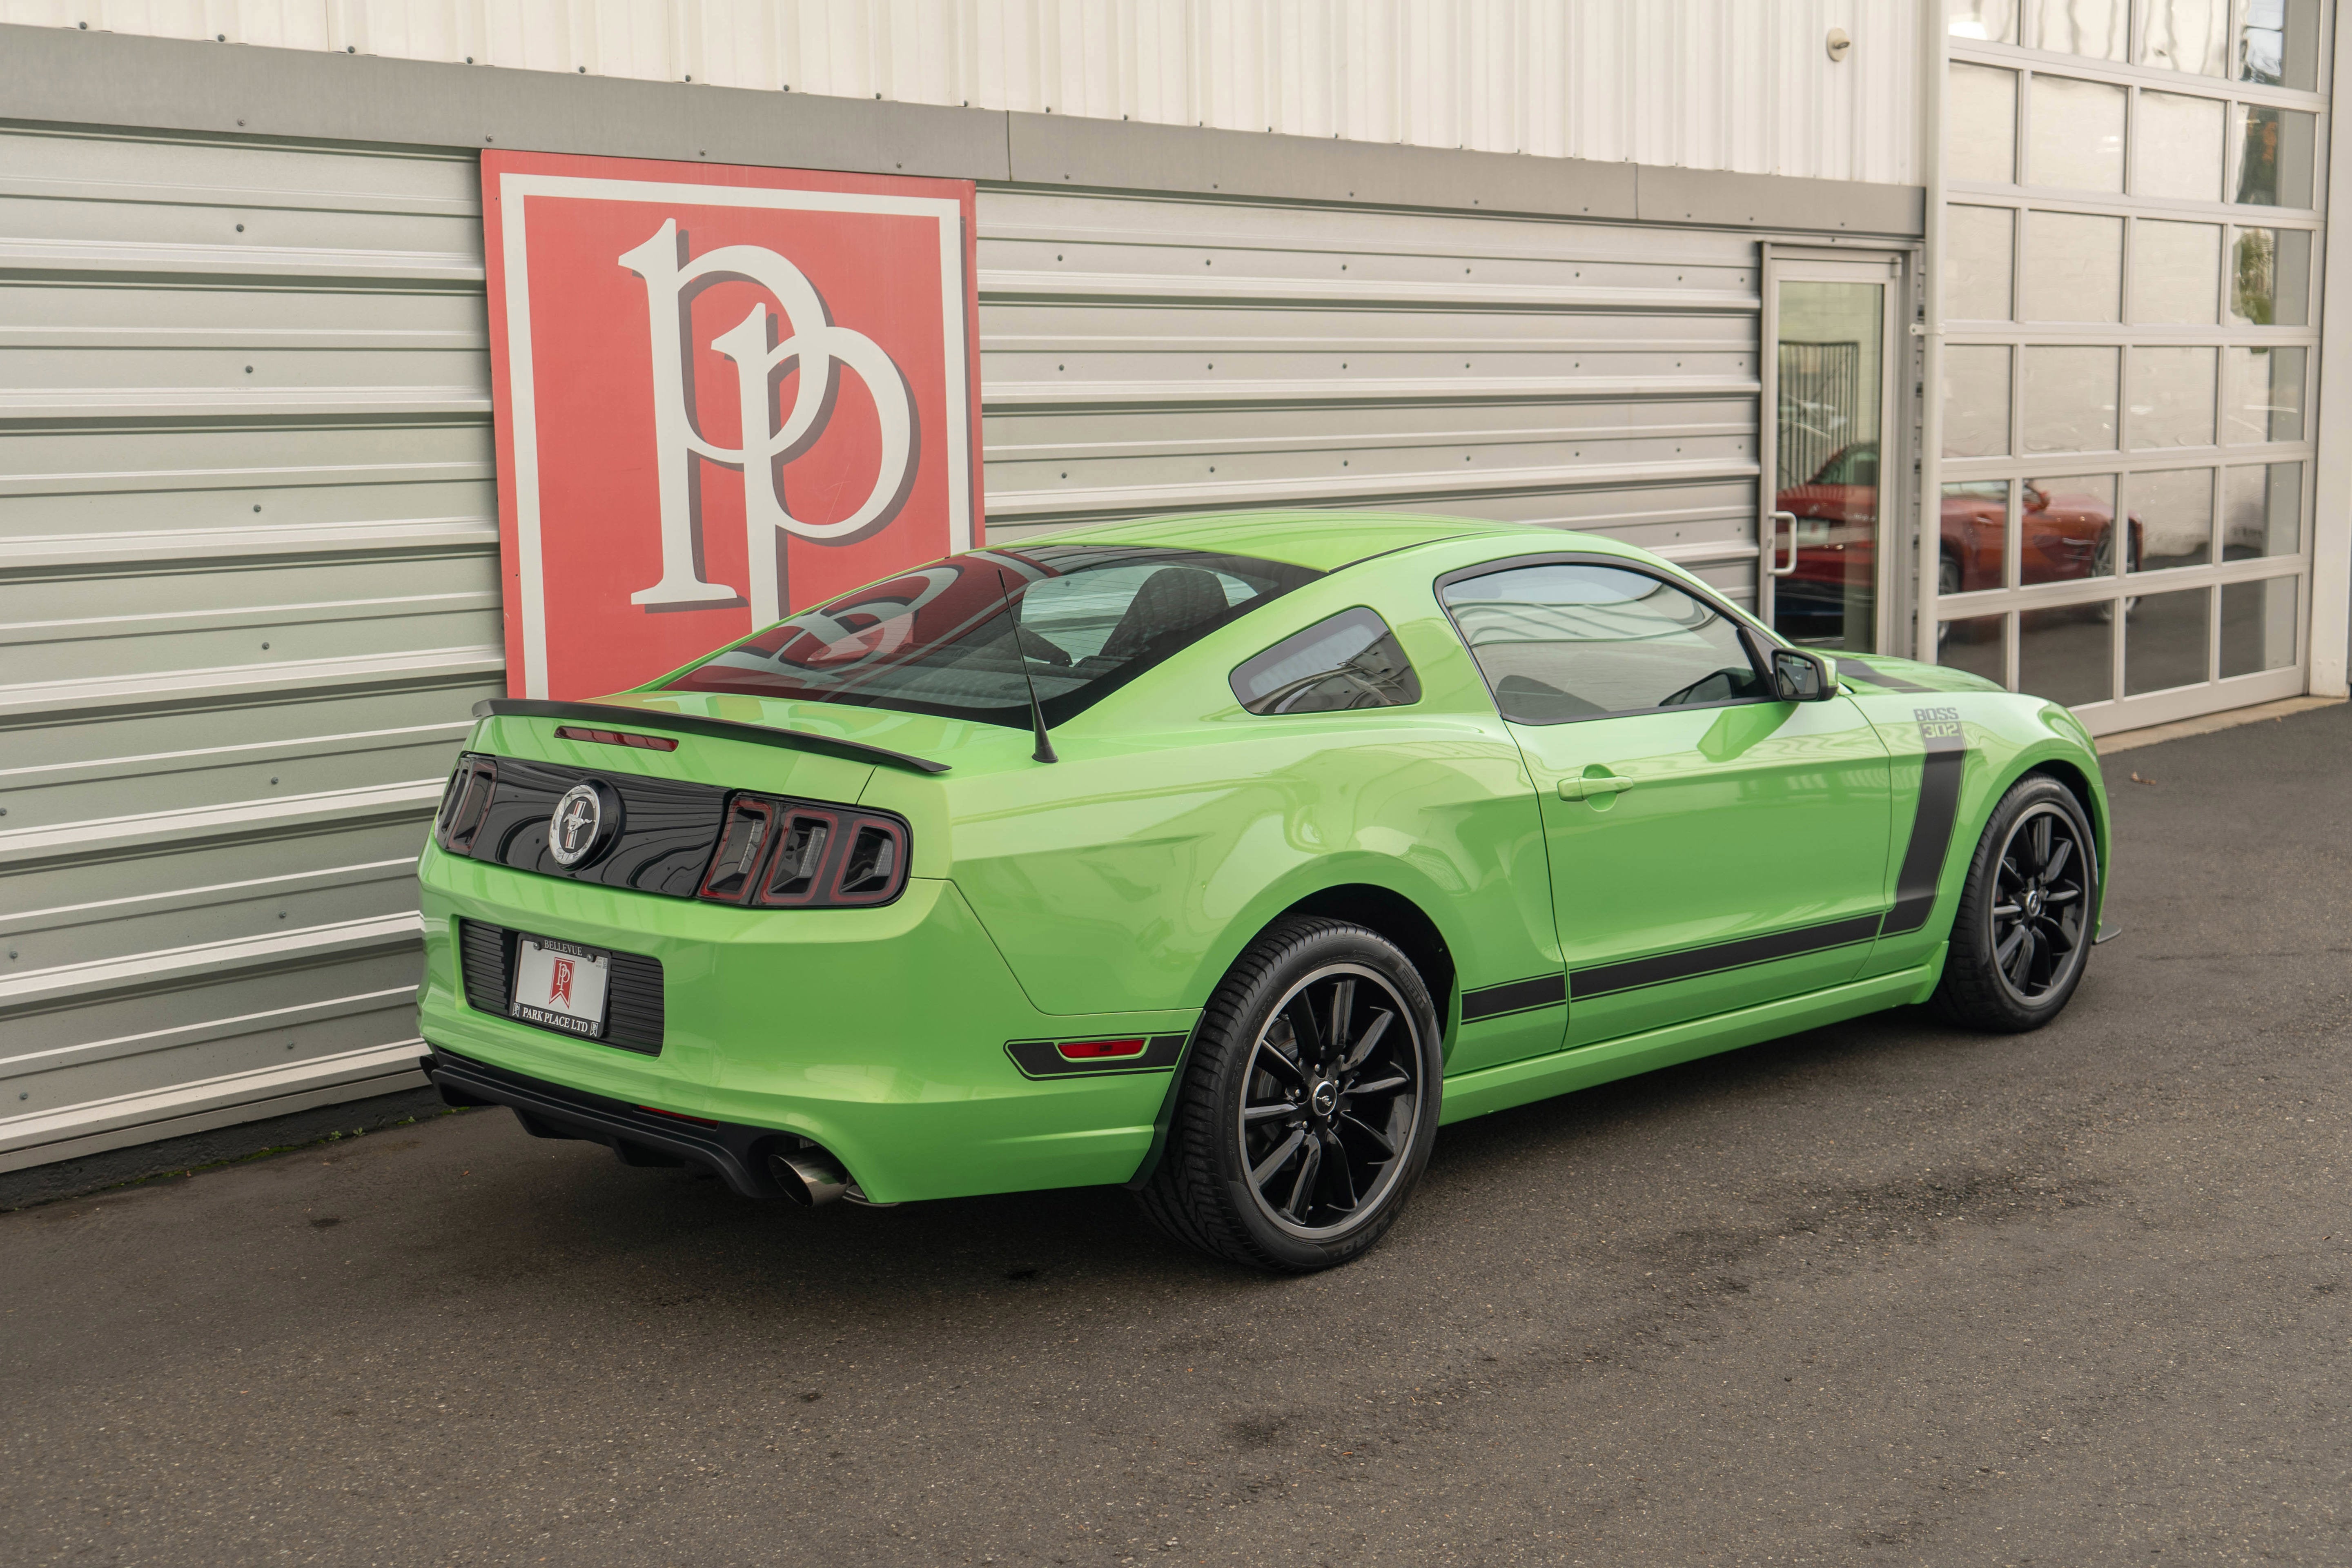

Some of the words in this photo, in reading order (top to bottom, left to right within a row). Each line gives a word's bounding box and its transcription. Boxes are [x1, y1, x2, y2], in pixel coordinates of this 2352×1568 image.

[1913, 707, 1959, 721] BOSS
[1922, 722, 1960, 738] 302
[544, 940, 583, 956] BELLEVUE
[522, 1007, 543, 1021] PARK
[544, 1012, 570, 1028] PLACE
[570, 1019, 588, 1033] LTD
